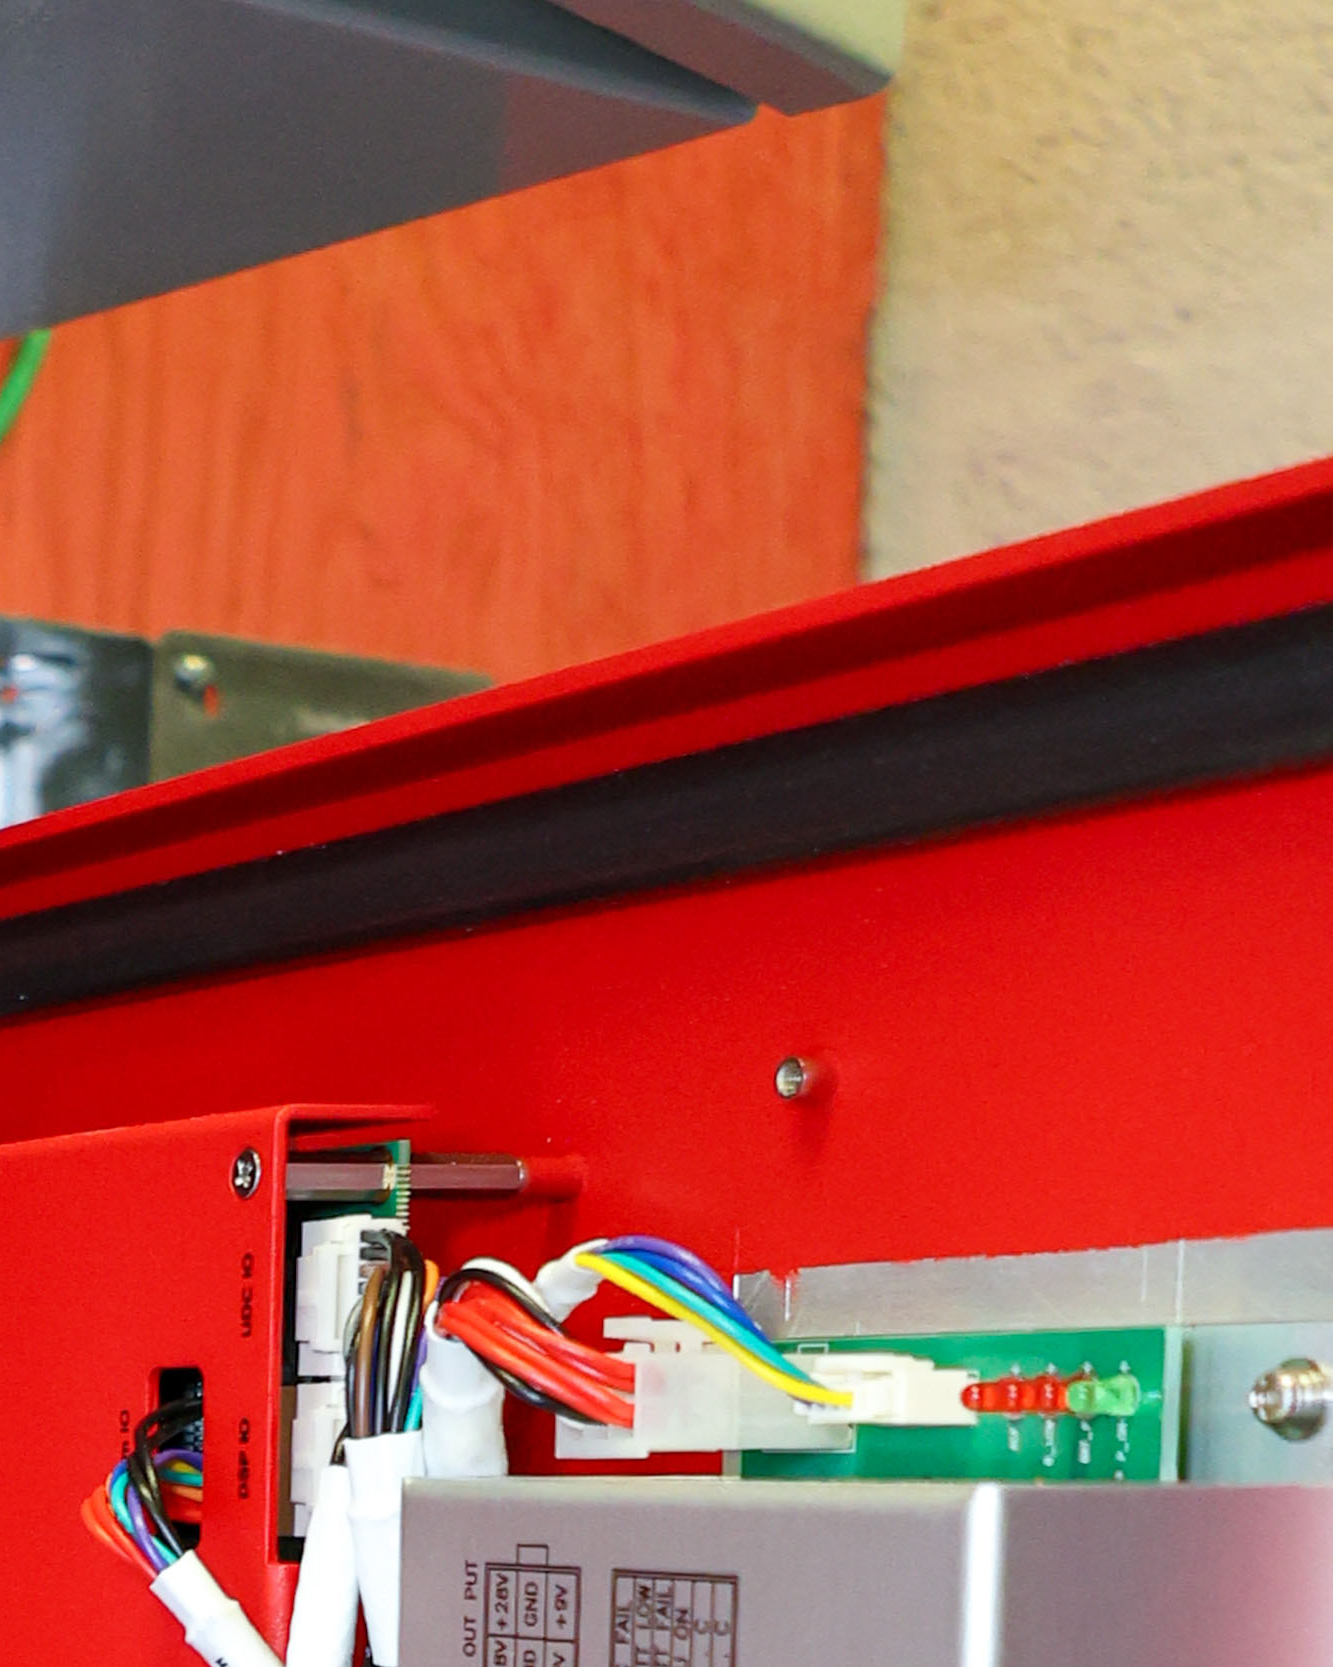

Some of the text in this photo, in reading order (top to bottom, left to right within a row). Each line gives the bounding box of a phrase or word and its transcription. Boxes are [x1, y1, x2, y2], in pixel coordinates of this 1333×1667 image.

[464, 1560, 478, 1600] PUT
[494, 1573, 510, 1630] +28V
[523, 1581, 539, 1627] GND
[462, 1616, 478, 1657] OUT
